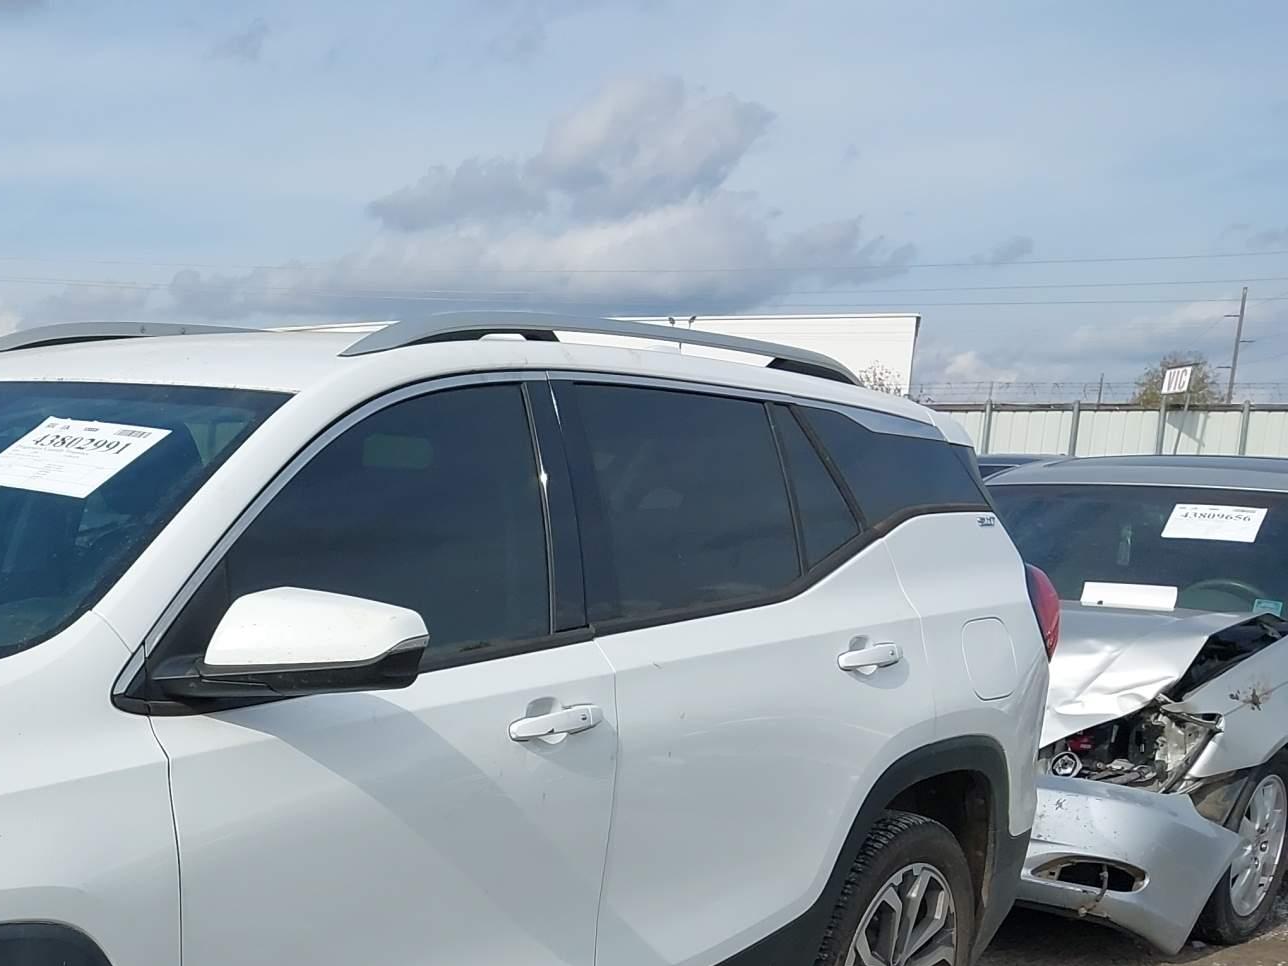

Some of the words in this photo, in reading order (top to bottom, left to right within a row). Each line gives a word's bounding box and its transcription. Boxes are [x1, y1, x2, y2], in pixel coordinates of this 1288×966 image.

[1167, 368, 1188, 391] VIC
[32, 433, 132, 455] 43802991
[1179, 511, 1252, 523] 43809656
